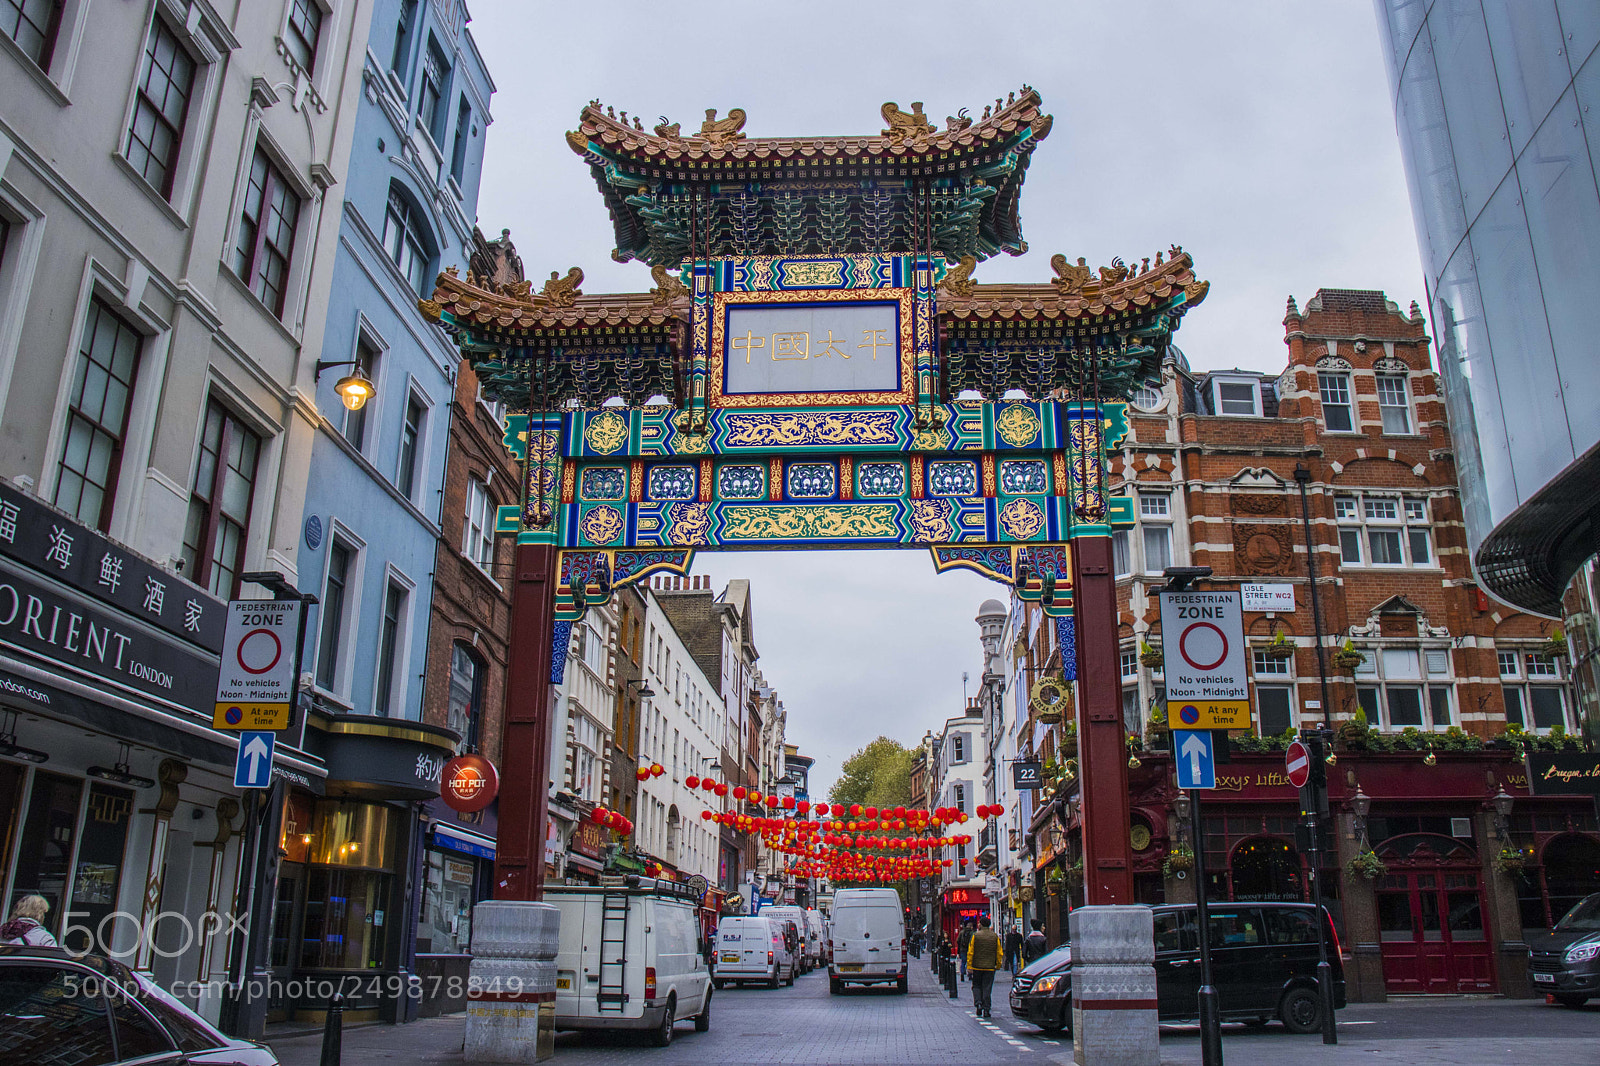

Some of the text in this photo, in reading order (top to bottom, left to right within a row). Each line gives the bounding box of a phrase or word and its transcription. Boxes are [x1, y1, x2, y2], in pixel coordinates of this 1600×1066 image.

[731, 329, 894, 364] 中國太平
[1168, 595, 1233, 604] PEDESTRIAN
[235, 603, 294, 612] PEDESTRIAN
[1178, 606, 1225, 619] ZONE
[241, 614, 284, 626] ZONE
[0, 584, 174, 690] ORIENT LONDON
[230, 679, 280, 687] No vehicles
[1178, 675, 1234, 684] No vehicles
[220, 690, 243, 698] Noon
[249, 690, 288, 700] Midnight
[1170, 688, 1195, 696] Noon
[1202, 688, 1245, 697] Midnight
[263, 709, 279, 717] any
[1208, 706, 1239, 715] At any
[254, 716, 274, 725] time
[1213, 716, 1235, 724] time
[1020, 768, 1036, 780] 22
[449, 779, 486, 788] HOT POT
[557, 980, 568, 988] RX
